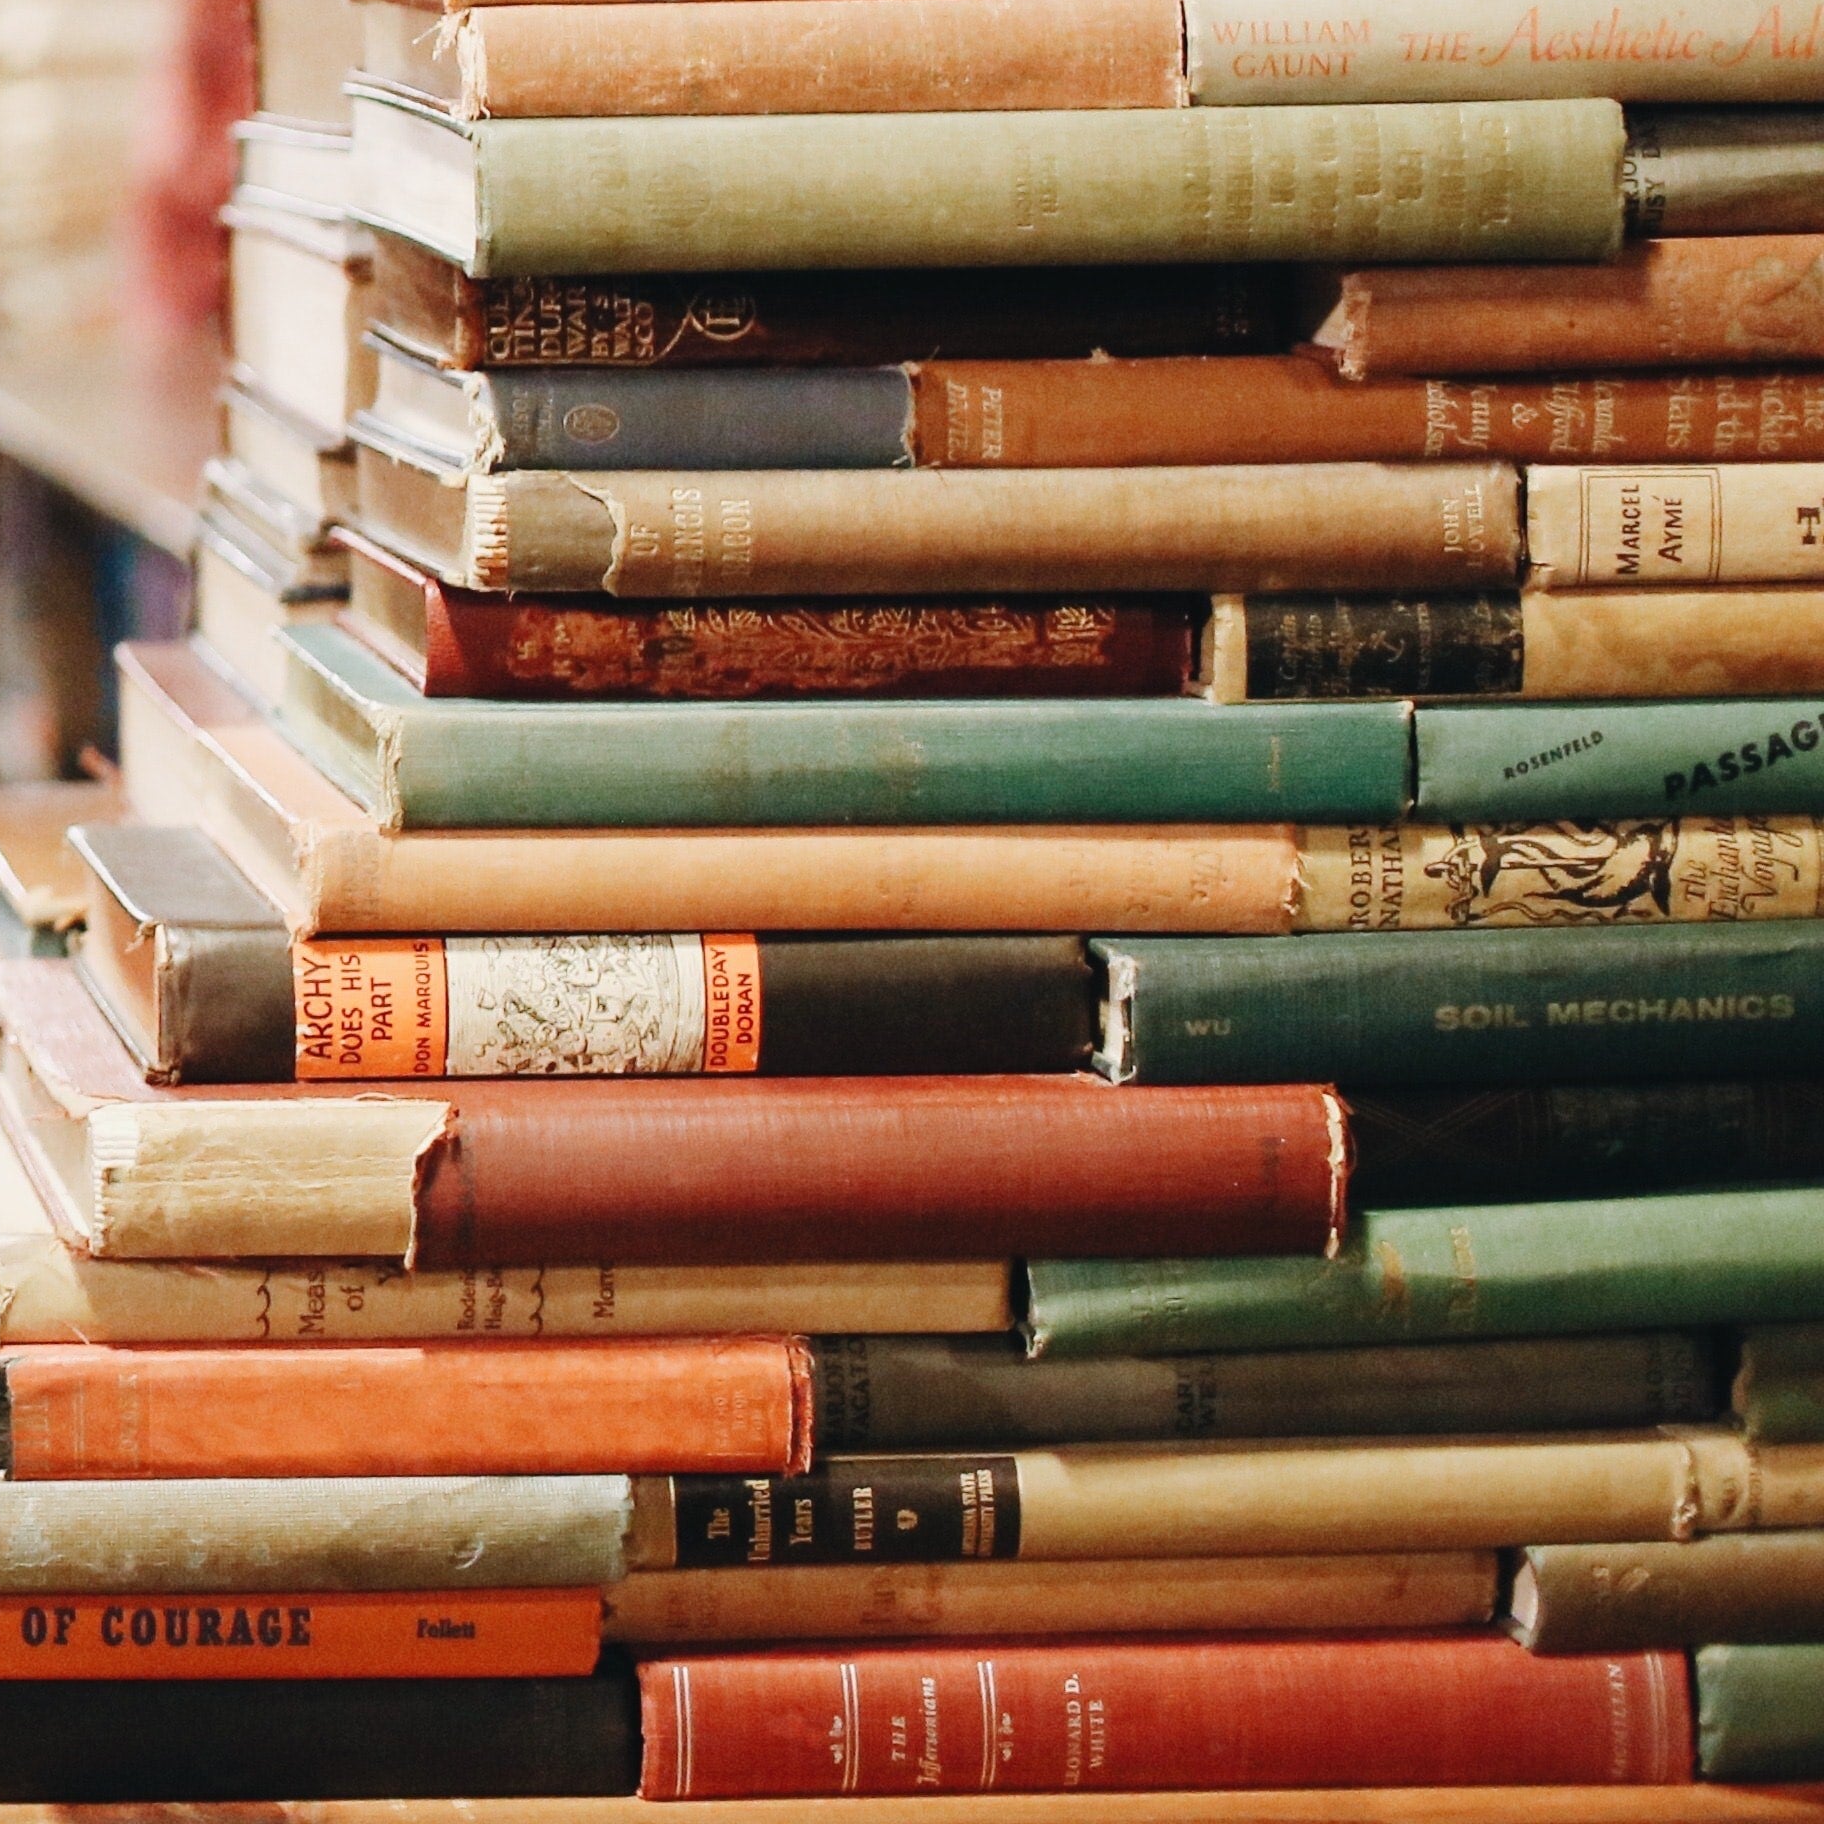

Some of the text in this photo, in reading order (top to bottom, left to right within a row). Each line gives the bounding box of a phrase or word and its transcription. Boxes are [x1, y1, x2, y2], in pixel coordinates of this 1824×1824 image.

[1213, 19, 1372, 47] WILLIAM
[1401, 13, 1702, 64] THE Aesthetic
[1233, 51, 1356, 79] GAUNT
[1616, 482, 1639, 575] MARCEL
[1654, 492, 1686, 565] AYMÉ
[1502, 730, 1605, 781] ROSENFELD
[304, 954, 332, 1062] ARCHY
[340, 953, 363, 1066] DOES HIS
[371, 975, 394, 1041] PART
[413, 942, 429, 1072] DON MARQUIS
[709, 944, 728, 1068] DOUBLEDAY
[736, 972, 753, 1047] DORAN
[1185, 1018, 1231, 1036] WU
[1434, 995, 1795, 1031] SOIL MECHANICS
[709, 1507, 729, 1540] The
[790, 1499, 812, 1547] Years
[853, 1485, 873, 1551] BUTLER
[20, 1610, 74, 1644] OF
[99, 1608, 311, 1645] COURAGE
[415, 1619, 476, 1640] Follett
[916, 1676, 937, 1788] Jeffersonians
